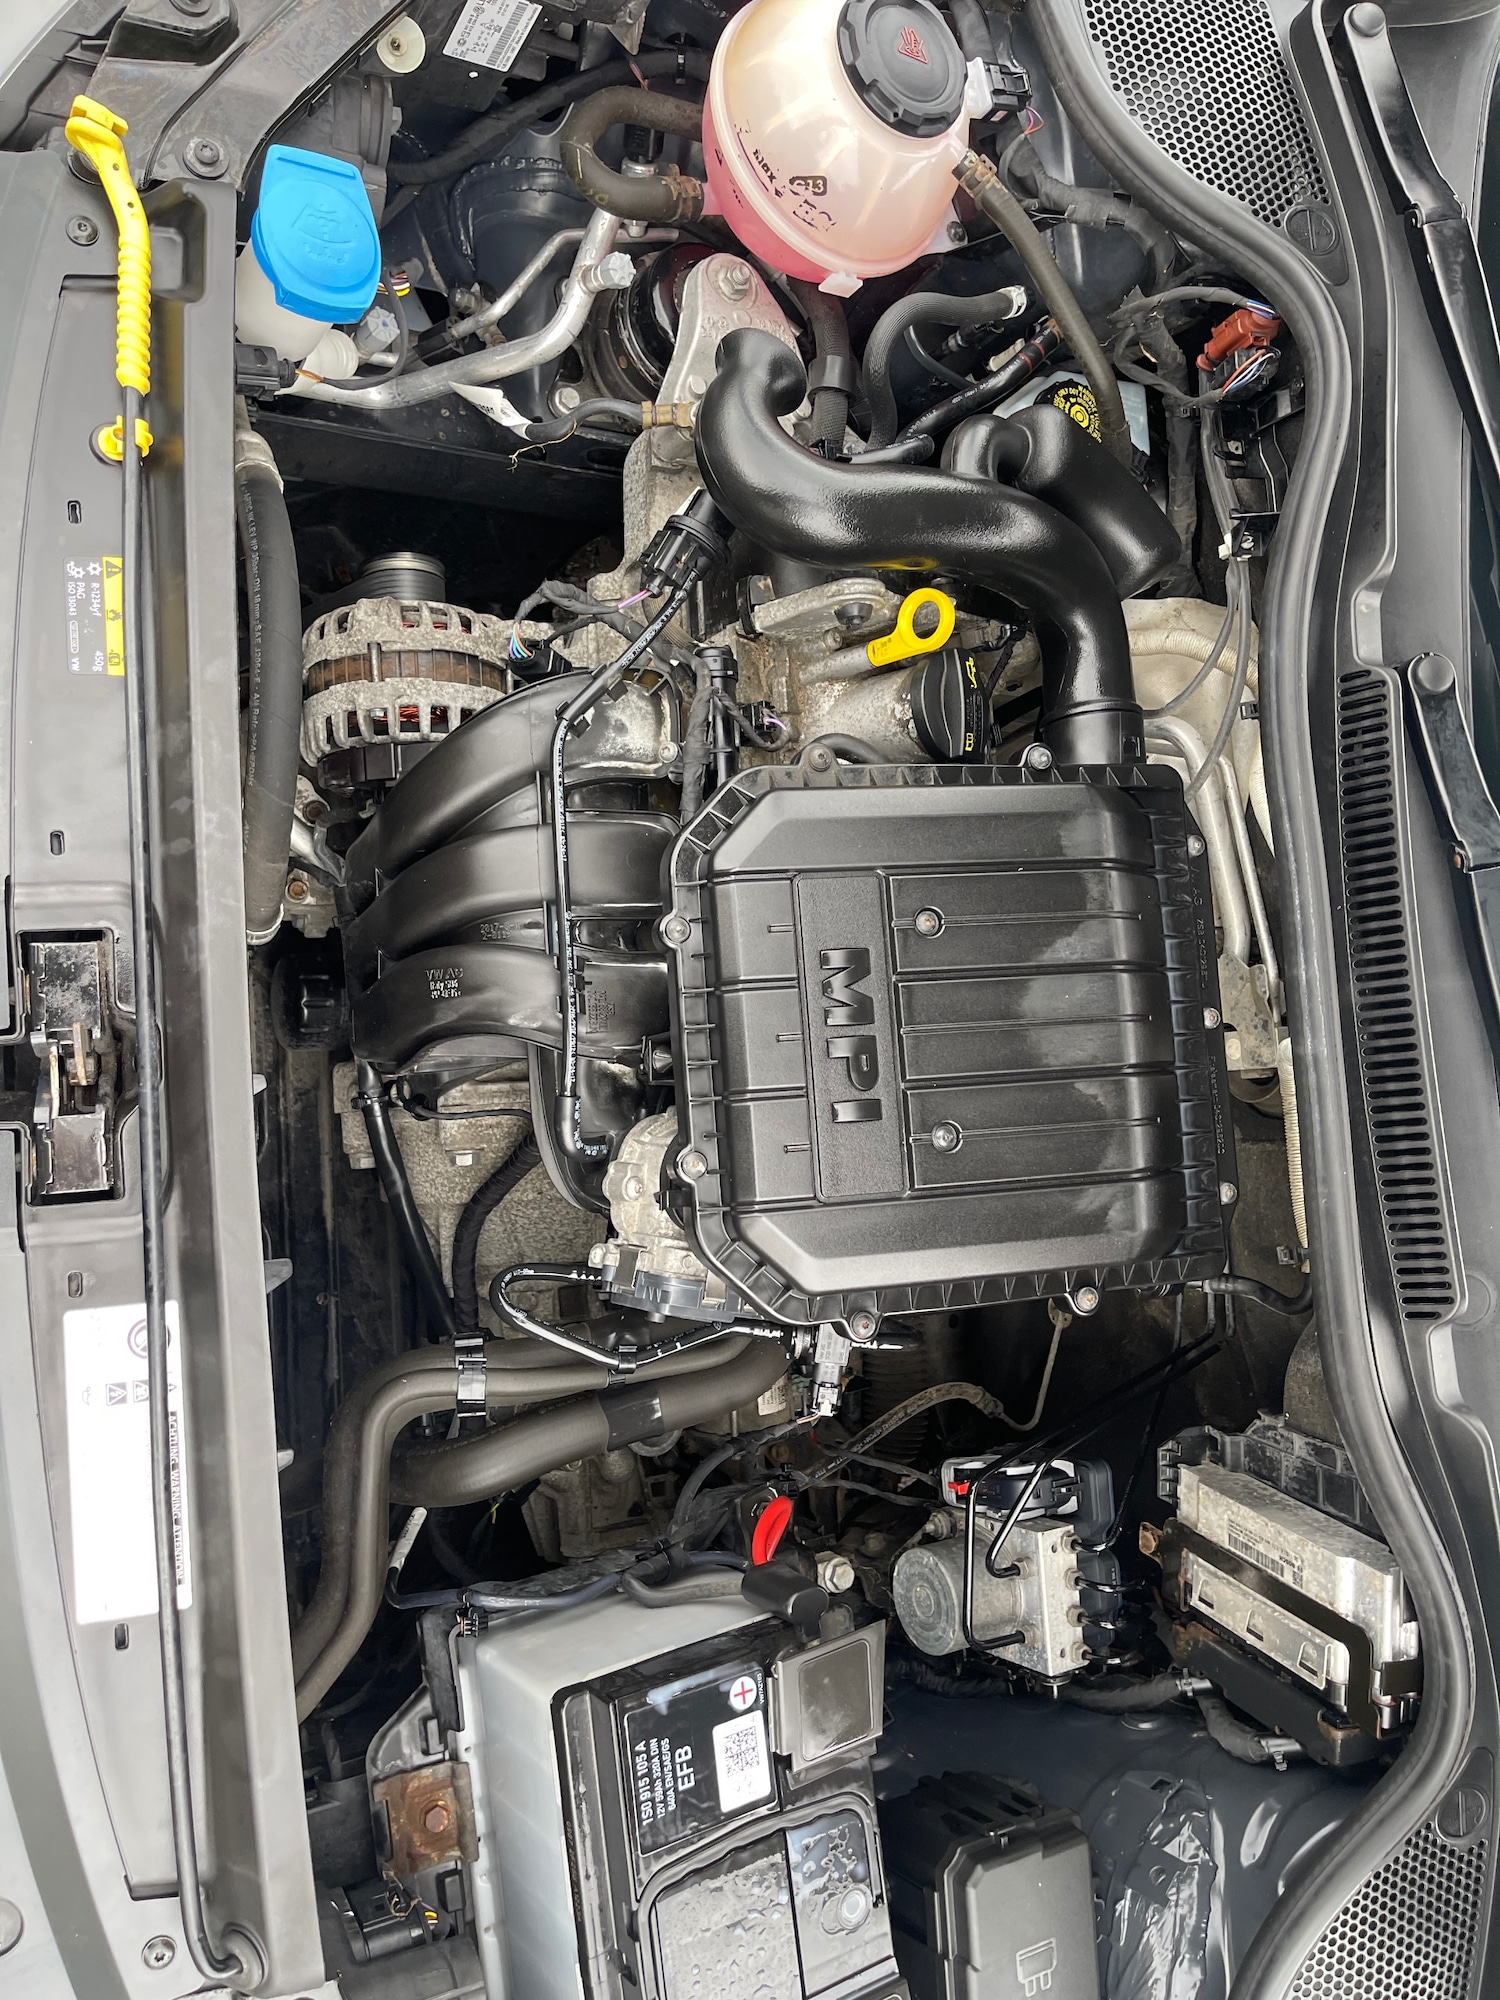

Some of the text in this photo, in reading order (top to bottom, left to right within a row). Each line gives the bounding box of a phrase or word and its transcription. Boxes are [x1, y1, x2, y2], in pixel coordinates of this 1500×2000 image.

[248, 522, 256, 537] LEV
[250, 539, 258, 551] WP
[69, 596, 77, 615] 13043
[77, 582, 85, 599] PAG
[90, 583, 104, 671] R-1234yf 450g
[71, 658, 79, 671] VW
[820, 948, 883, 1124] MPI
[169, 1415, 184, 1579] ACHTUNG WARNING ATTENTION
[635, 1740, 654, 1825] 1S0 915 105 A
[650, 1738, 666, 1818] 12V 59Ah 320A DIN
[661, 1738, 677, 1810] 640A EN/SAE/GS
[675, 1745, 696, 1790] EFB
